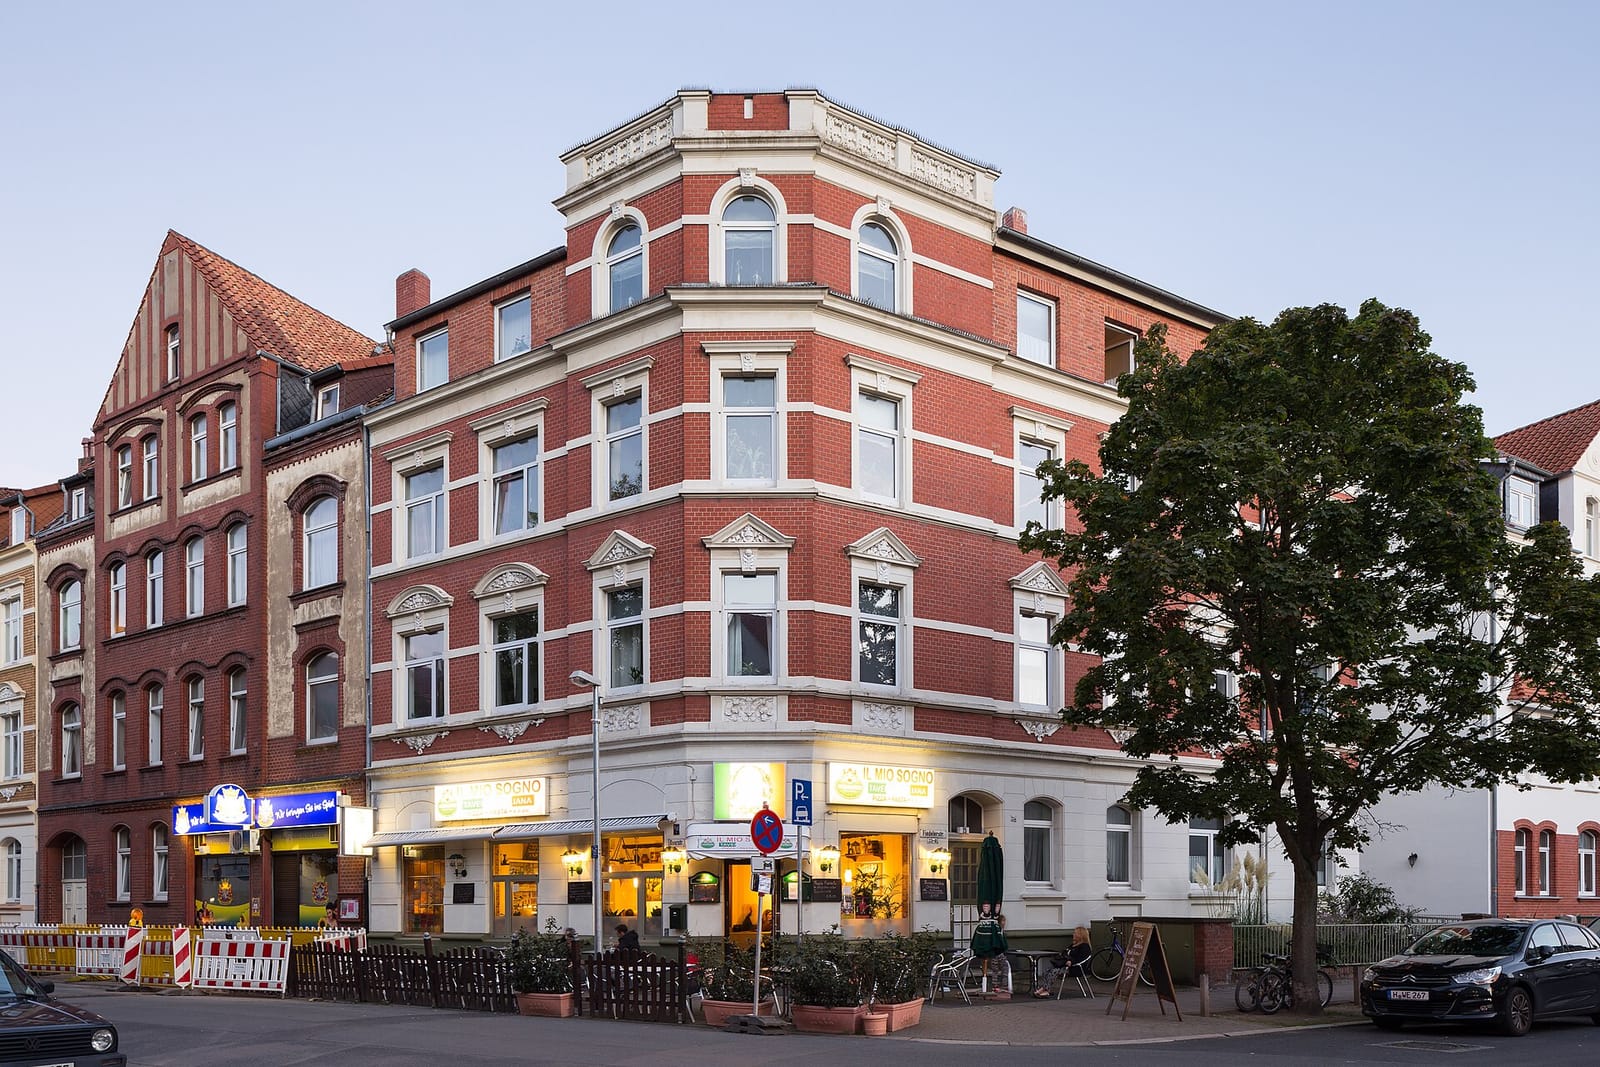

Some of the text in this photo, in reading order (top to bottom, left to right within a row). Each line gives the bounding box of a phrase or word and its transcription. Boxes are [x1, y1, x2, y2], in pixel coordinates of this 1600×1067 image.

[863, 766, 933, 785] IL MIO SOGNO
[495, 779, 541, 797] SOGNO
[795, 782, 804, 801] P
[1412, 991, 1426, 999] 267
